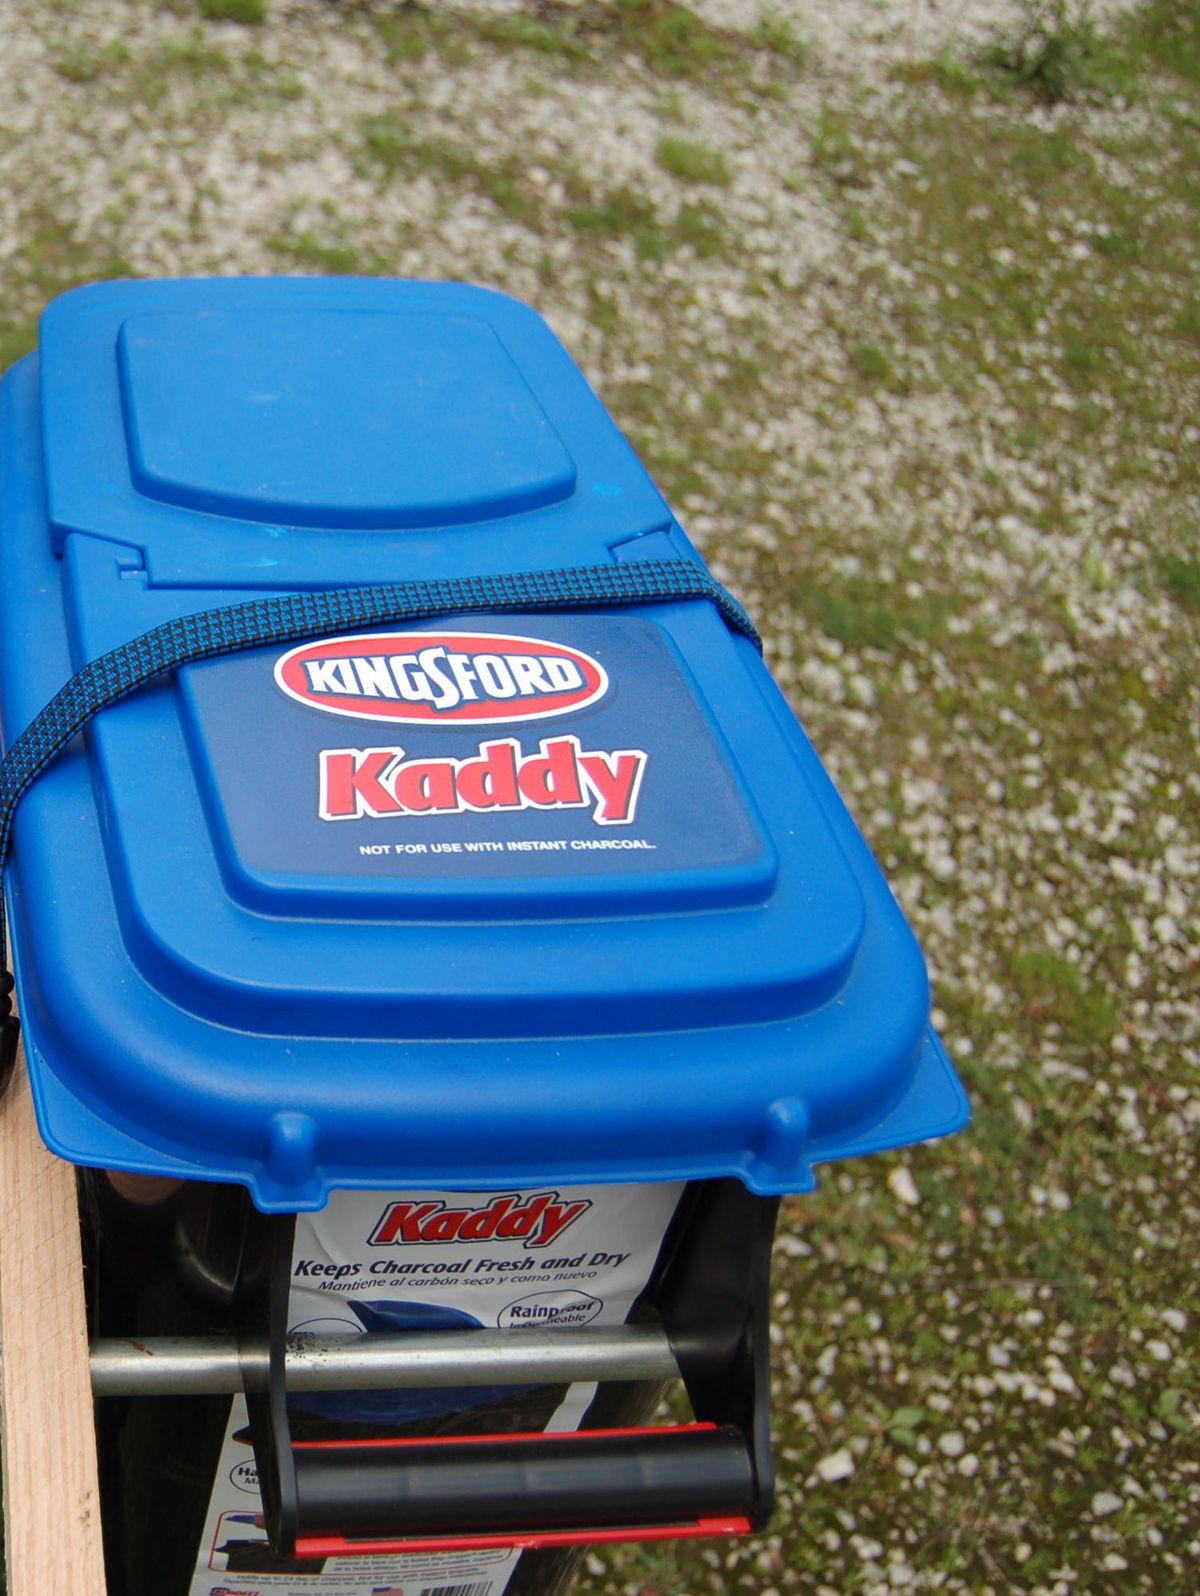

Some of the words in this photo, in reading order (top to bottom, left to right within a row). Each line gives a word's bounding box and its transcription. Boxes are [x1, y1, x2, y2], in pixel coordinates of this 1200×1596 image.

[304, 647, 583, 709] KINGSFORD
[319, 735, 647, 825] Kaddy
[359, 845, 391, 856] NOT
[395, 844, 428, 854] FOR
[431, 842, 463, 853] USE
[464, 841, 503, 852] WITH
[507, 841, 567, 851] INSTANT
[570, 839, 657, 850] CHARCOAL.
[367, 1191, 593, 1249] Kaddy
[294, 1258, 362, 1279] Keeps
[369, 1258, 471, 1275] Charcoal
[473, 1255, 536, 1274] Fresh
[540, 1253, 586, 1270] and
[587, 1251, 631, 1269] Dry
[318, 1276, 386, 1293] Mantiene
[389, 1277, 405, 1288] al
[407, 1274, 458, 1287] carbón
[461, 1277, 495, 1286] seco
[499, 1276, 508, 1285] y
[510, 1273, 550, 1283] como
[553, 1270, 597, 1280] nuevo
[510, 1301, 595, 1319] Rainproof
